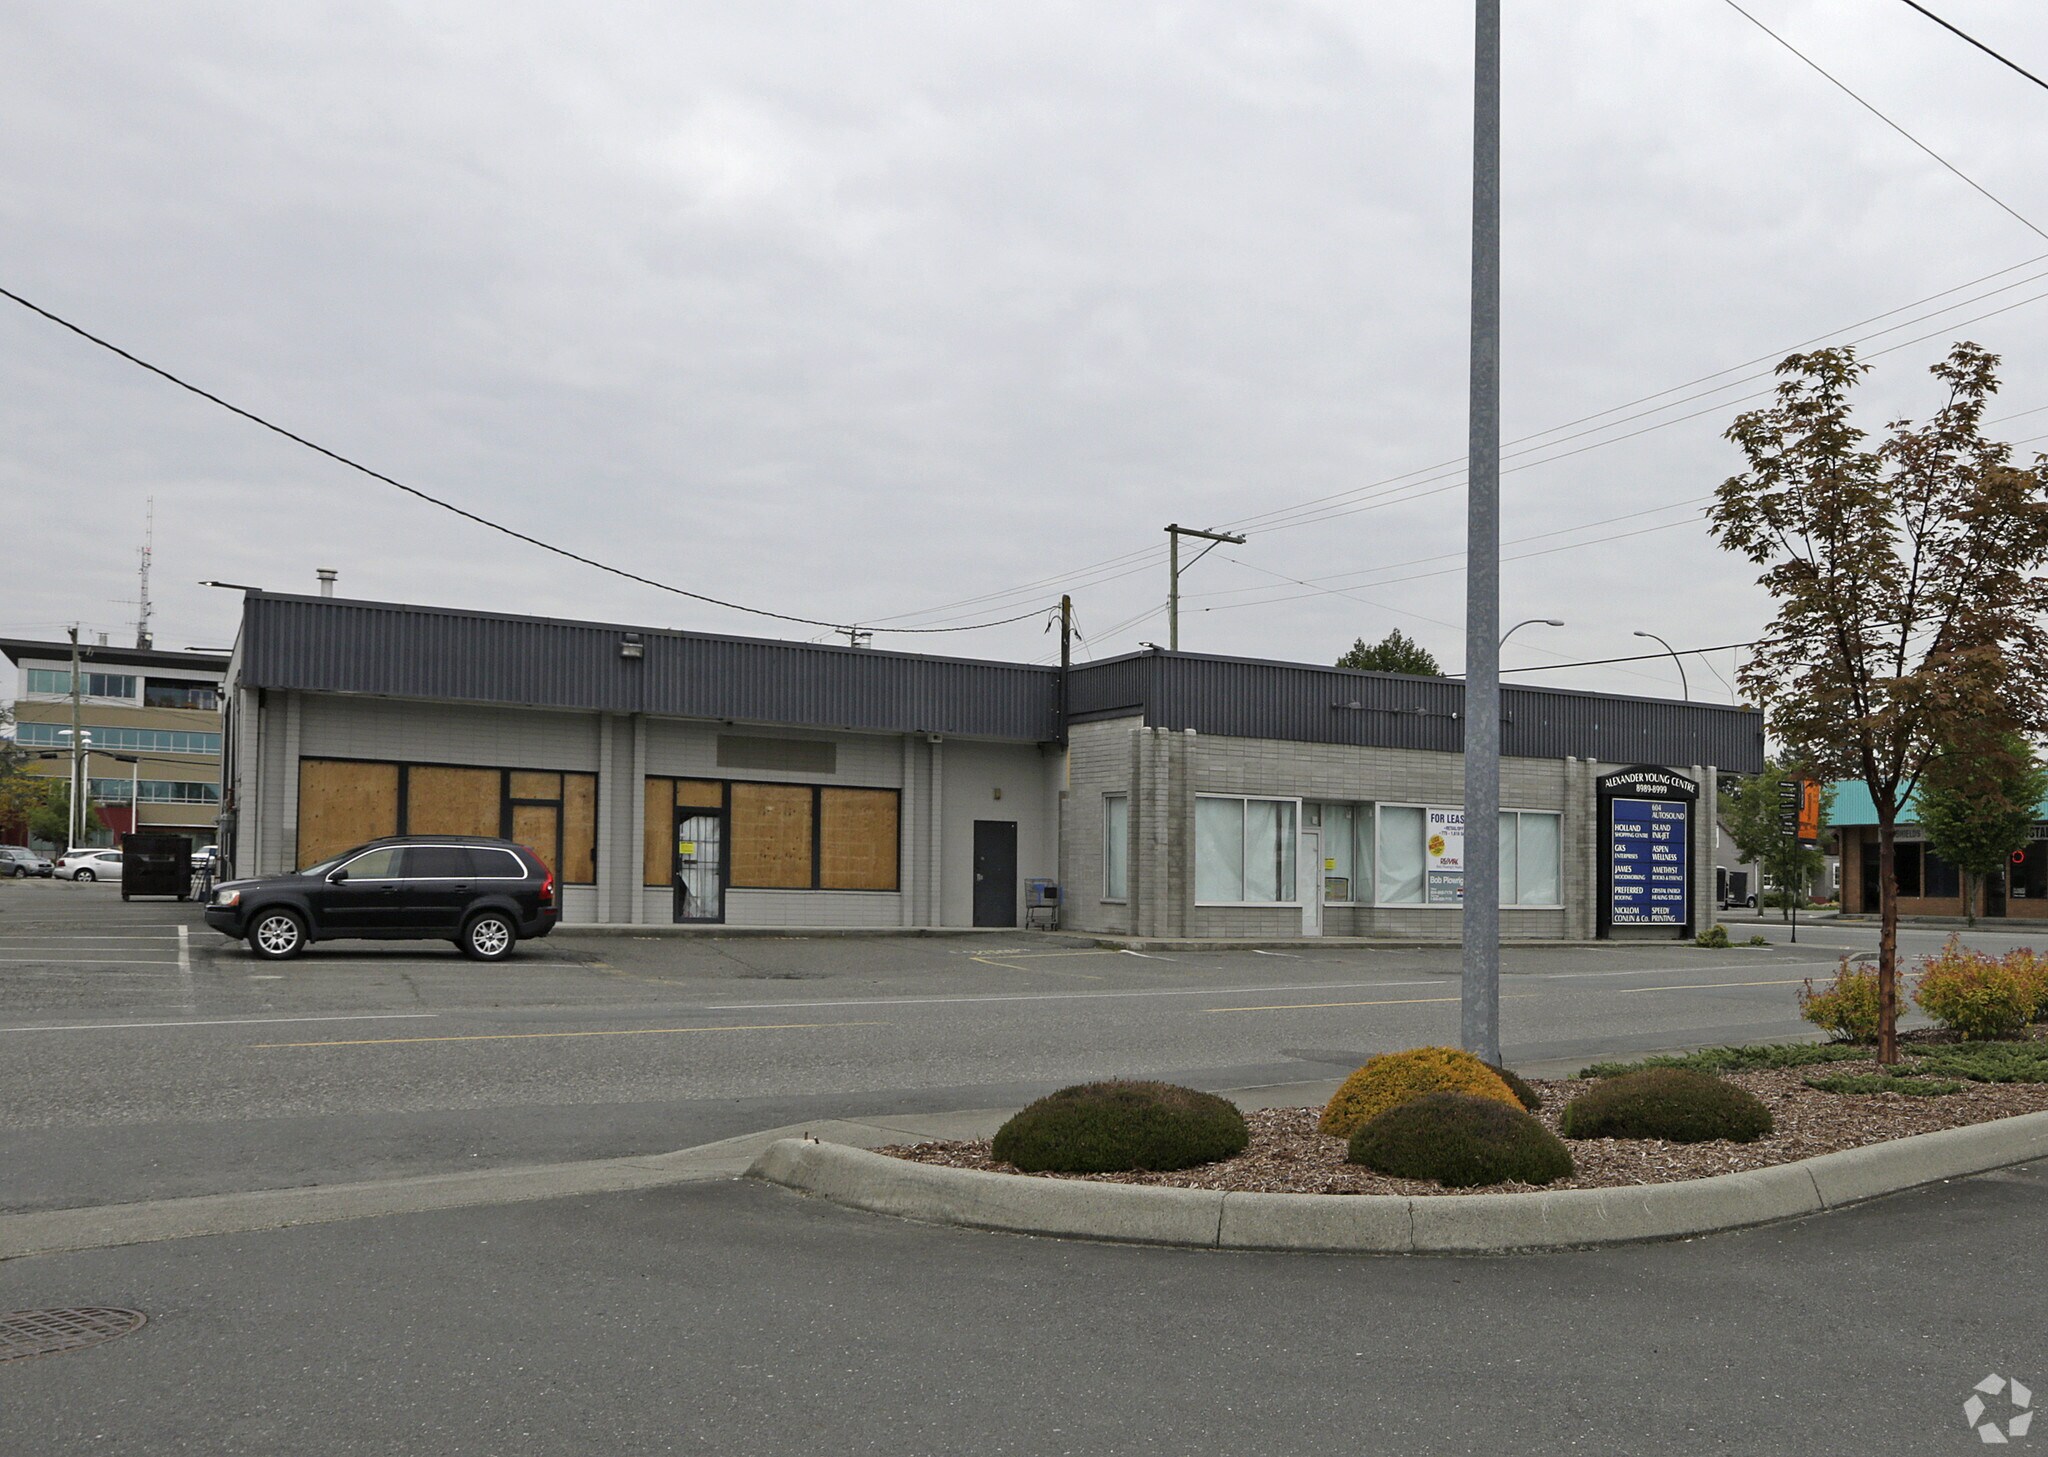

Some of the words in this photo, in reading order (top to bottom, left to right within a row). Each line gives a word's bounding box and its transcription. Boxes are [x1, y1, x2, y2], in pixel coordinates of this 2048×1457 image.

[1605, 773, 1644, 788] ALEXANDER
[1645, 773, 1670, 784] YOUNG
[1671, 776, 1696, 794] CENTRE
[1635, 784, 1667, 793] 8989-8999
[1431, 813, 1445, 823] FOR
[1447, 814, 1464, 824] LEAS
[1652, 812, 1685, 820] AUTOSOUND
[1614, 824, 1641, 832] HOLLAND
[1652, 823, 1671, 831] ISLAND
[1652, 845, 1669, 853] ASPEN
[1652, 853, 1677, 861] WELLNESS
[1614, 865, 1632, 874] JAMES
[1652, 866, 1678, 874] AMETHYST
[1430, 876, 1442, 884] Bob
[1443, 876, 1463, 887] Plowrig
[1614, 886, 1644, 894] PREFERRED
